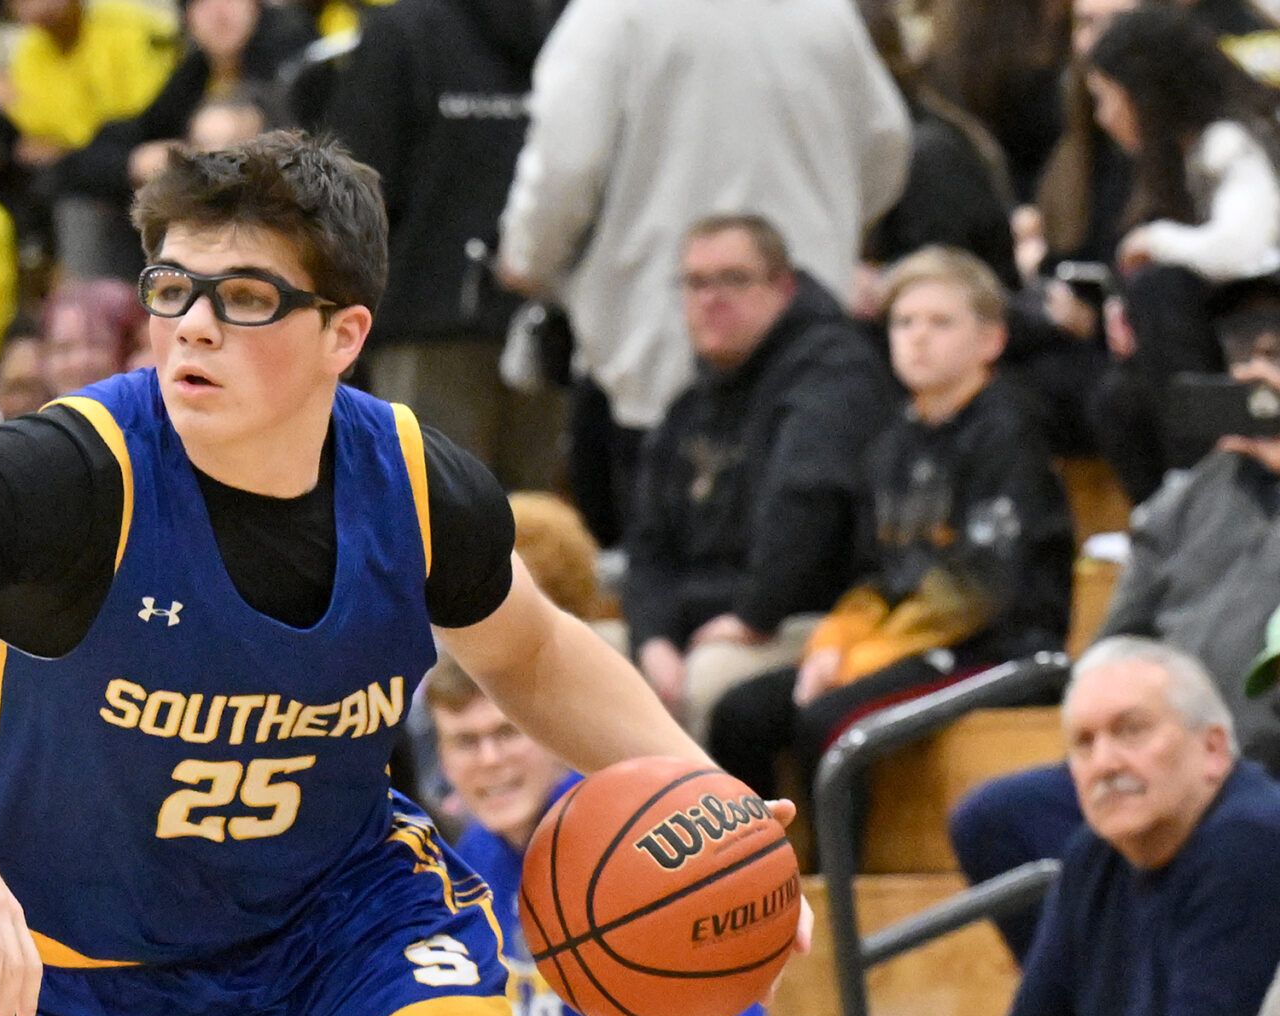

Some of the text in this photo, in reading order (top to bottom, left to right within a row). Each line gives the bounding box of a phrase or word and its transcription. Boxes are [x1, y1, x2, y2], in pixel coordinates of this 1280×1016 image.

[155, 755, 316, 842] 25
[691, 873, 800, 943] EVOLUTIO
[404, 933, 481, 987] S
